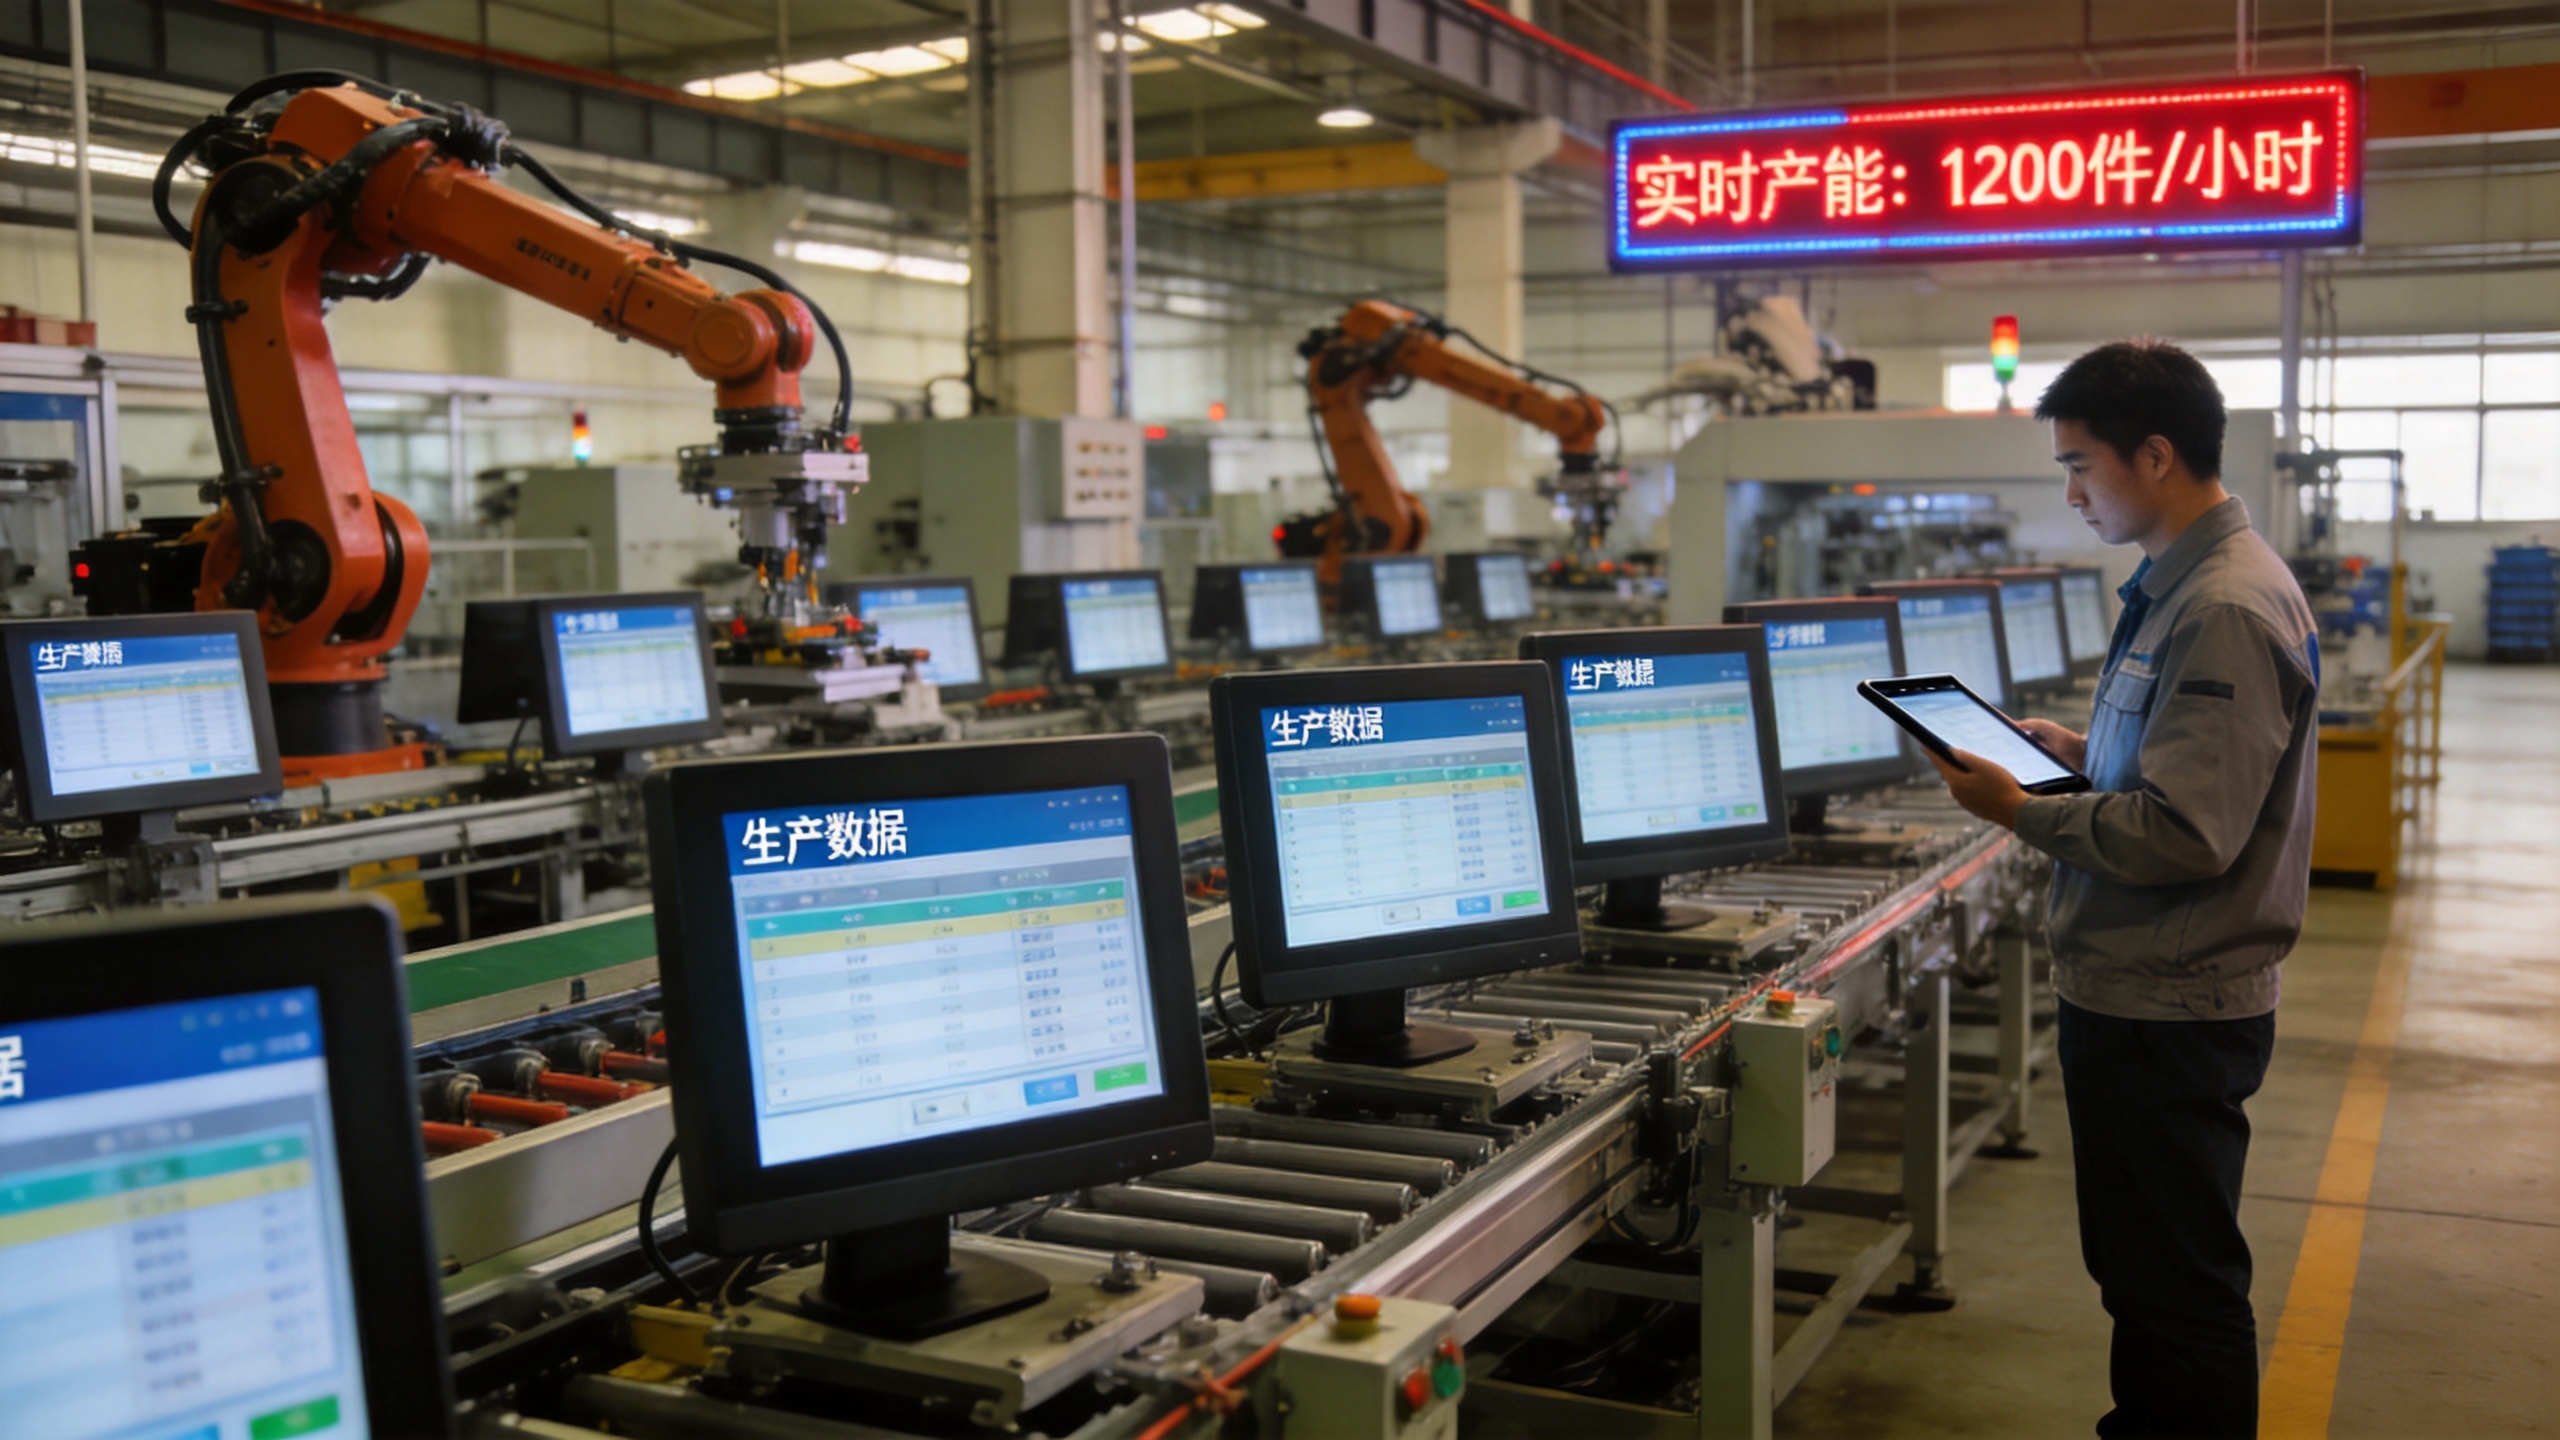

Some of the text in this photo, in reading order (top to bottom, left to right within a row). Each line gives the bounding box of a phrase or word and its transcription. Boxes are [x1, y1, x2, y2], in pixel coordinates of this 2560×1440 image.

[1270, 706, 1384, 747] 生产数据
[742, 808, 908, 866] 生产数据
